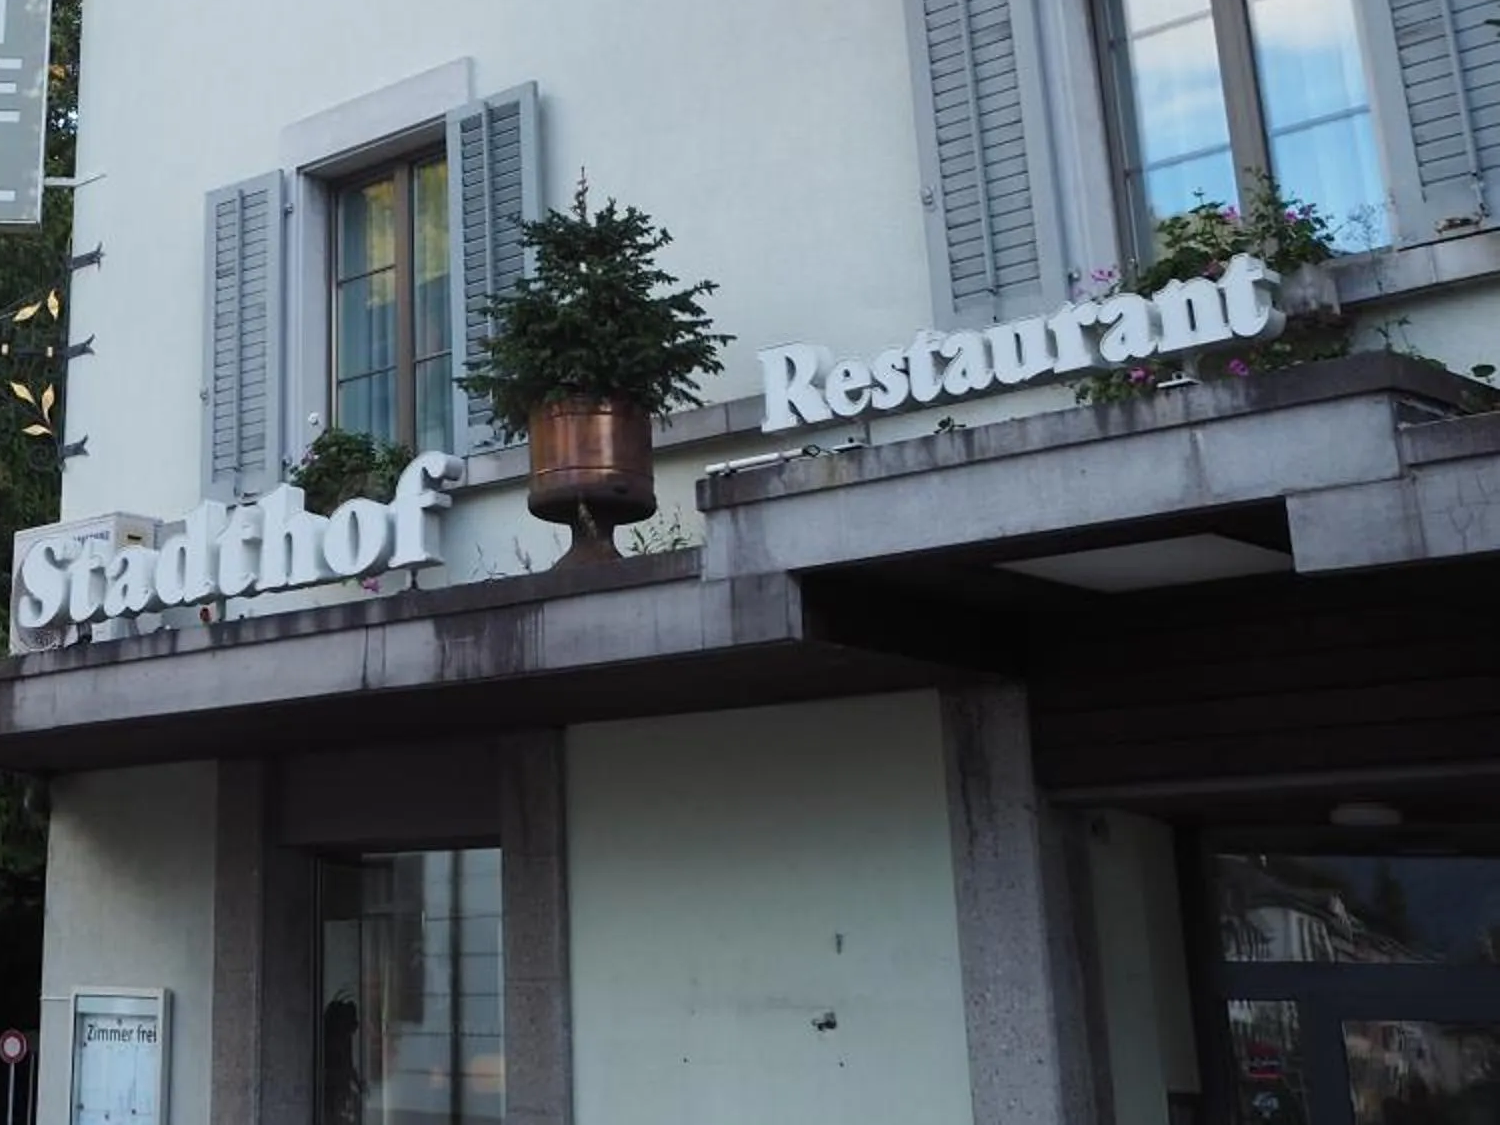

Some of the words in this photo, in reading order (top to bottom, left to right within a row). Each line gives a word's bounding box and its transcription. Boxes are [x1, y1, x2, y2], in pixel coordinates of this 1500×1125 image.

[756, 252, 1282, 432] Restaurant
[17, 450, 464, 628] Stadthof
[87, 1023, 134, 1043] Zimmer
[136, 1024, 157, 1044] frei
